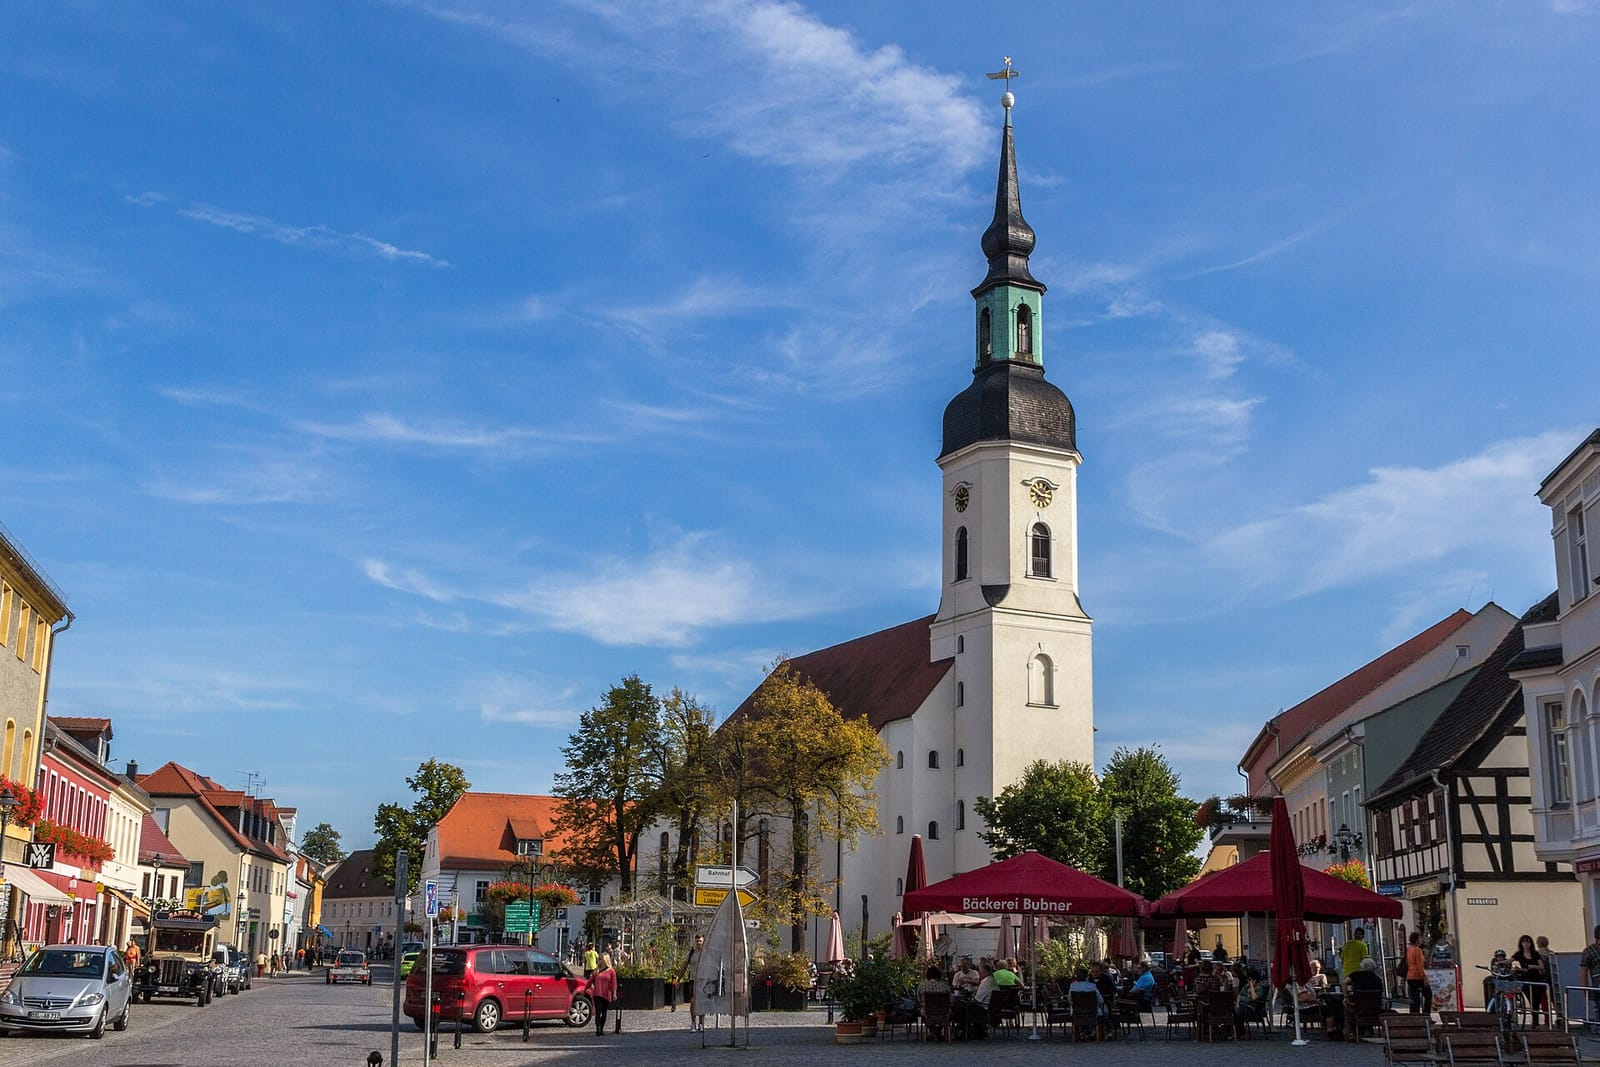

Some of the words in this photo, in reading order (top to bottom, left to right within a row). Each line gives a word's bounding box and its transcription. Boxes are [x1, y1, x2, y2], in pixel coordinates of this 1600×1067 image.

[962, 897, 1018, 910] Bäckerei
[1023, 897, 1072, 911] Bubner
[557, 908, 565, 919] P
